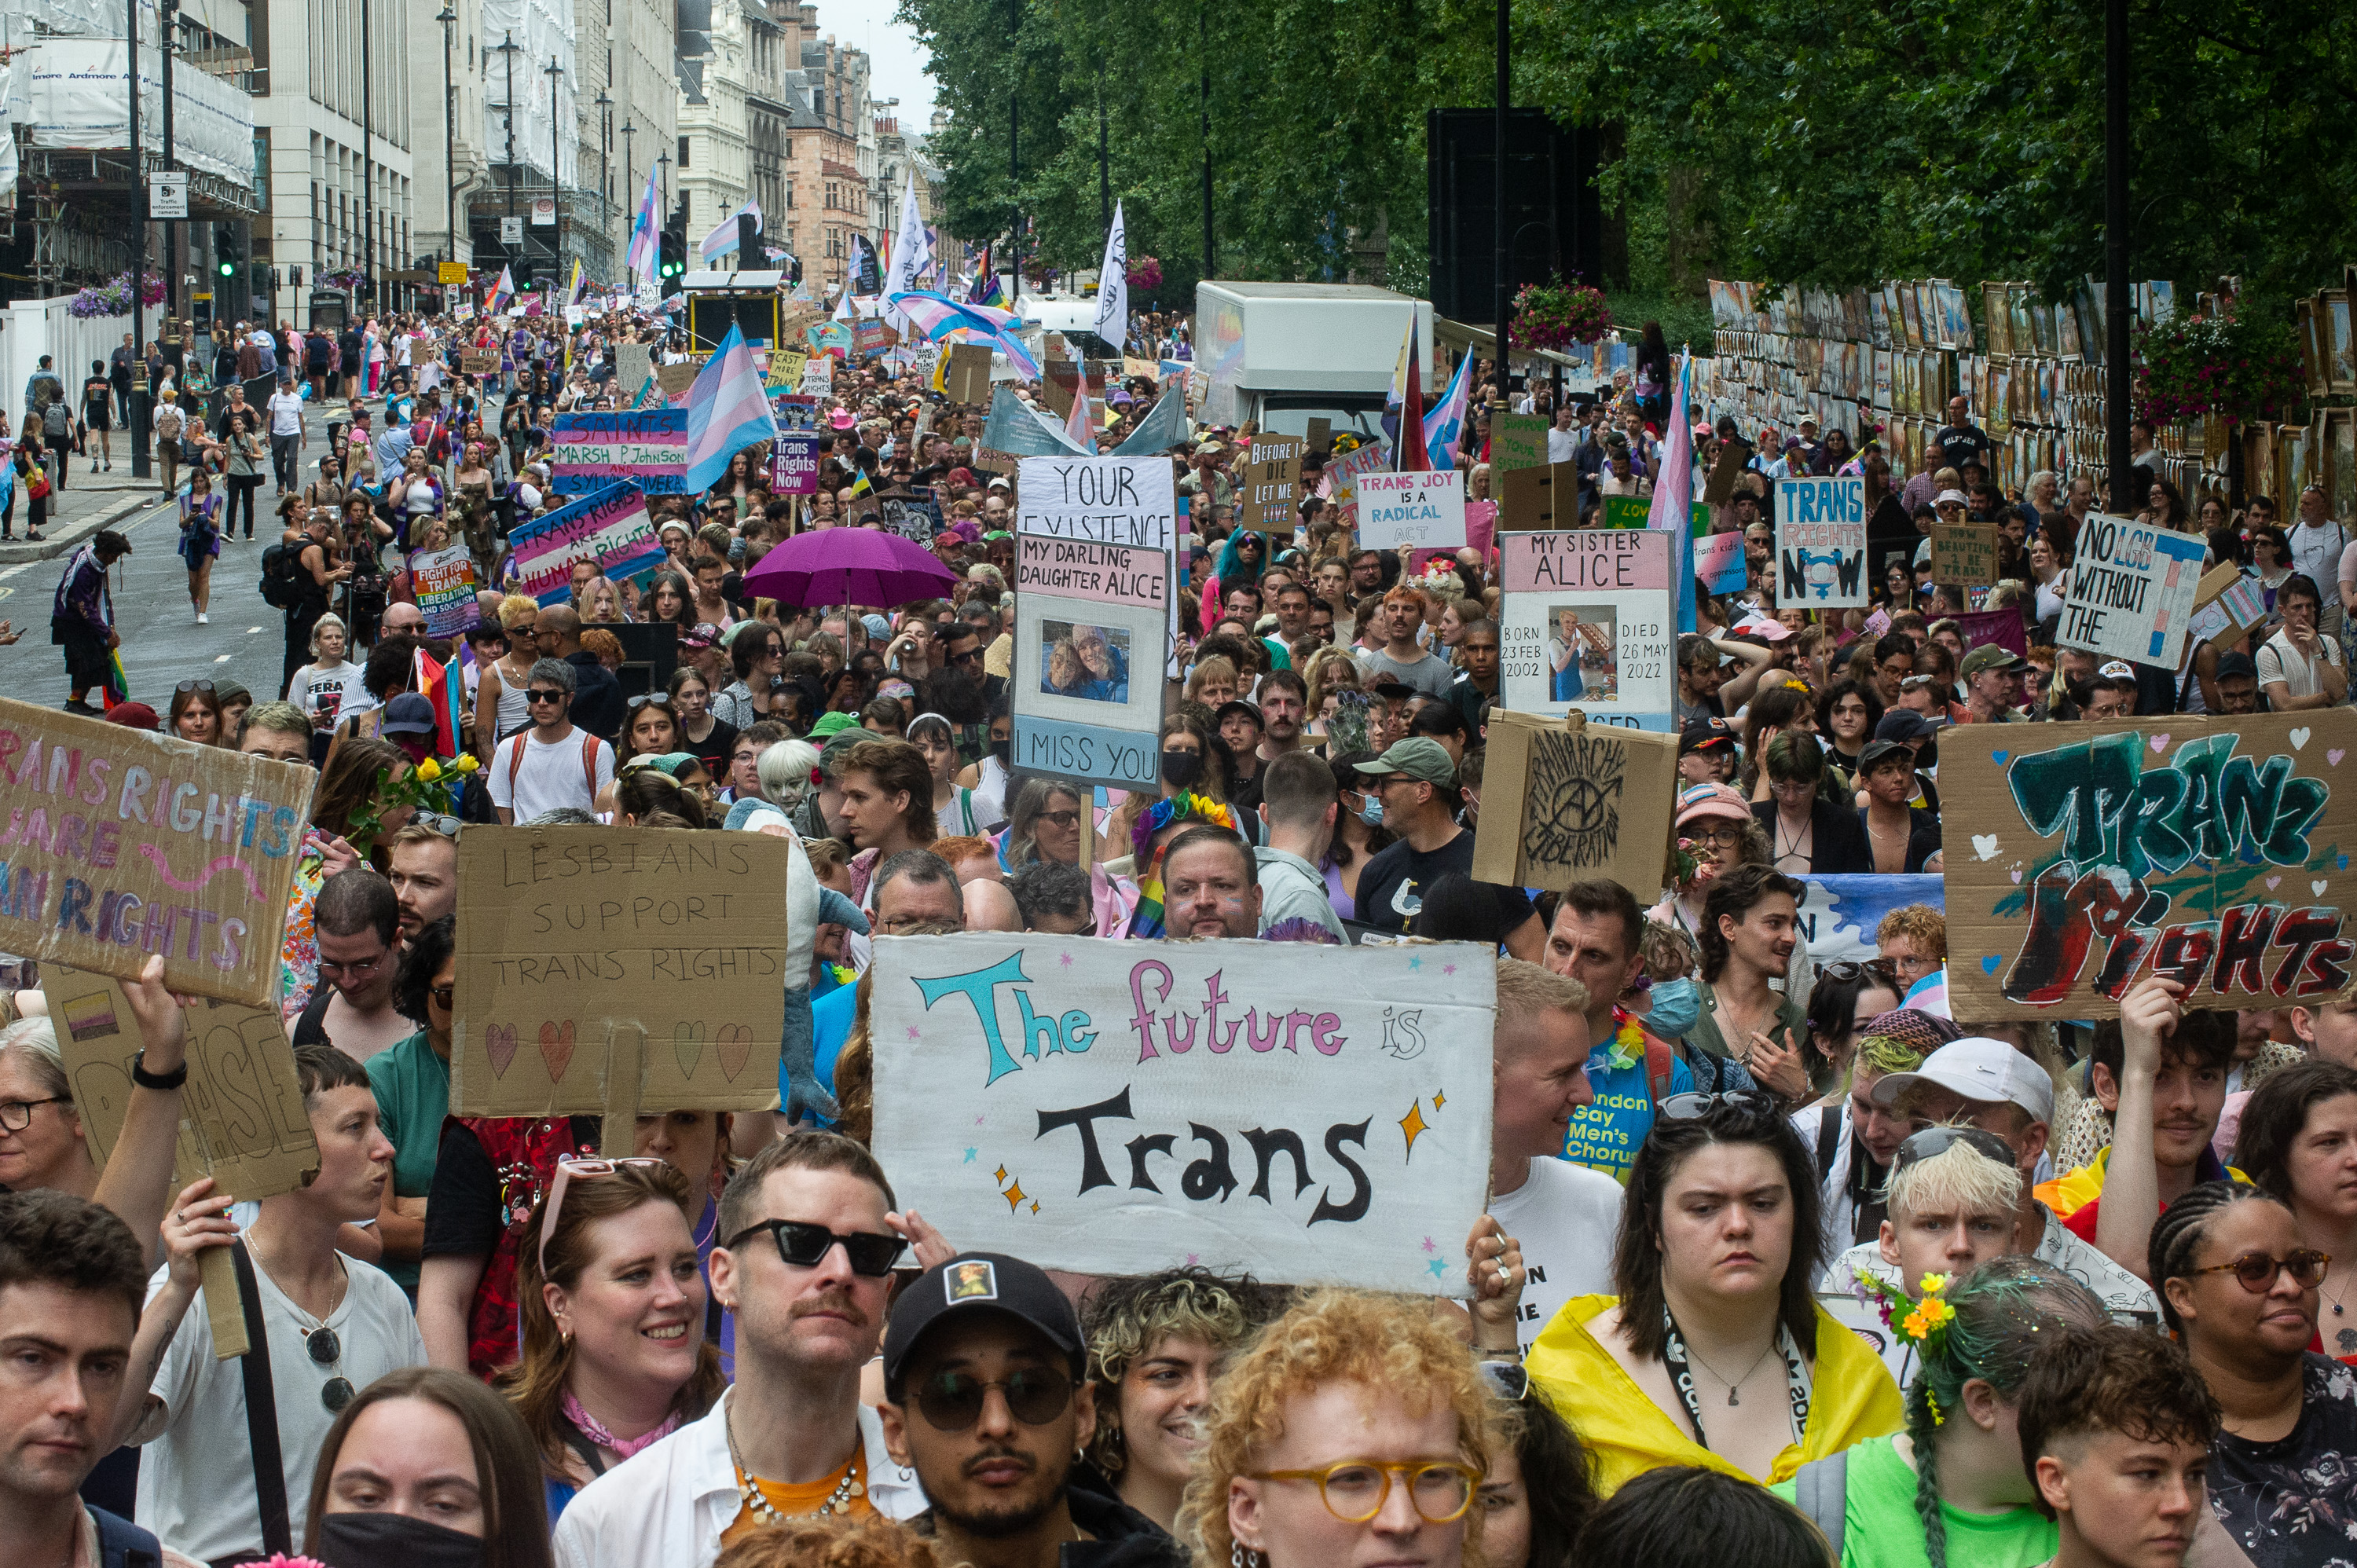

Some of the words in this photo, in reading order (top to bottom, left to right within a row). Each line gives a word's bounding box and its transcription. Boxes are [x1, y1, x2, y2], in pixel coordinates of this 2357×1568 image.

[775, 354, 801, 365] CAST
[775, 365, 796, 375] MORE
[805, 385, 830, 394] RIGHTS
[1503, 416, 1549, 432] SUPPORT
[558, 446, 610, 463] MARSH
[777, 438, 808, 455] Trans
[1252, 443, 1290, 465] BEFORE
[1295, 442, 1299, 459] I
[1505, 436, 1536, 458] YOUR
[610, 465, 633, 474] AND
[777, 455, 816, 474] Rights
[1266, 460, 1287, 481] DIE
[775, 471, 802, 489] Now
[1053, 465, 1139, 507] YOUR
[1360, 475, 1414, 491] TRANS
[1422, 472, 1453, 488] JOY
[1255, 484, 1274, 505] LET
[1277, 483, 1292, 500] ME
[1401, 492, 1411, 504] IS
[1417, 491, 1426, 503] A
[1781, 481, 1863, 523] TRANS
[1263, 504, 1288, 524] LIVE
[1372, 505, 1441, 523] RADICAL
[1621, 504, 1650, 517] LOV
[516, 511, 585, 549] TRANS
[570, 528, 600, 550] ARE
[1394, 526, 1428, 542] ACT
[1783, 524, 1864, 548] RIGHTS
[595, 523, 656, 566] RIGHTS
[1531, 535, 1557, 554] MY
[1567, 532, 1640, 552] SISTER
[1720, 540, 1739, 553] kids
[2080, 518, 2116, 562] NO
[2113, 526, 2154, 571] LGB
[1024, 540, 1050, 561] MY
[1055, 544, 1131, 570] DARLING
[418, 566, 449, 581] FIGHT
[449, 560, 468, 575] FOR
[1534, 554, 1634, 587] ALICE
[1709, 566, 1746, 581] oppressors
[1782, 548, 1864, 600] NOW
[1941, 564, 1986, 577] TRANS
[427, 573, 463, 592] TRANS
[1018, 565, 1100, 592] DAUGHTER
[1104, 571, 1163, 601] ALICE
[2072, 563, 2152, 614] WITHOUT
[420, 584, 473, 606] LIBERATION
[421, 606, 438, 616] AND
[439, 595, 475, 613] SOCIALISM
[427, 621, 478, 639] ocialistparty.org.uk
[1505, 628, 1540, 641] BORN
[1622, 624, 1659, 637] DIED
[2066, 603, 2107, 645] THE
[1501, 646, 1516, 659] 23
[1519, 646, 1541, 658] FEB
[1622, 643, 1639, 659] 26
[1644, 643, 1669, 658] MAY
[1506, 663, 1540, 677] 2002
[1627, 664, 1662, 678] 2022
[307, 681, 346, 694] FERA
[1016, 728, 1020, 764] I
[1031, 732, 1094, 772] MISS
[1105, 742, 1157, 781] YOU
[119, 765, 298, 859] RIGHTS
[21, 809, 121, 868] ARE
[504, 842, 750, 888] LESBIANS
[533, 894, 733, 933] SUPPORT
[58, 877, 247, 973] RIGHTS
[493, 951, 625, 985] TRANS
[651, 947, 777, 981] RIGHTS
[911, 948, 1100, 1089] The
[1129, 959, 1349, 1065] future
[1380, 1006, 1427, 1061] is
[75, 1011, 316, 1168] PASE
[1594, 1093, 1648, 1111] ndon
[1572, 1105, 1615, 1127] Gay
[1568, 1123, 1629, 1145] Men's
[1034, 1084, 1373, 1228] Trans
[1566, 1141, 1638, 1163] Chorus
